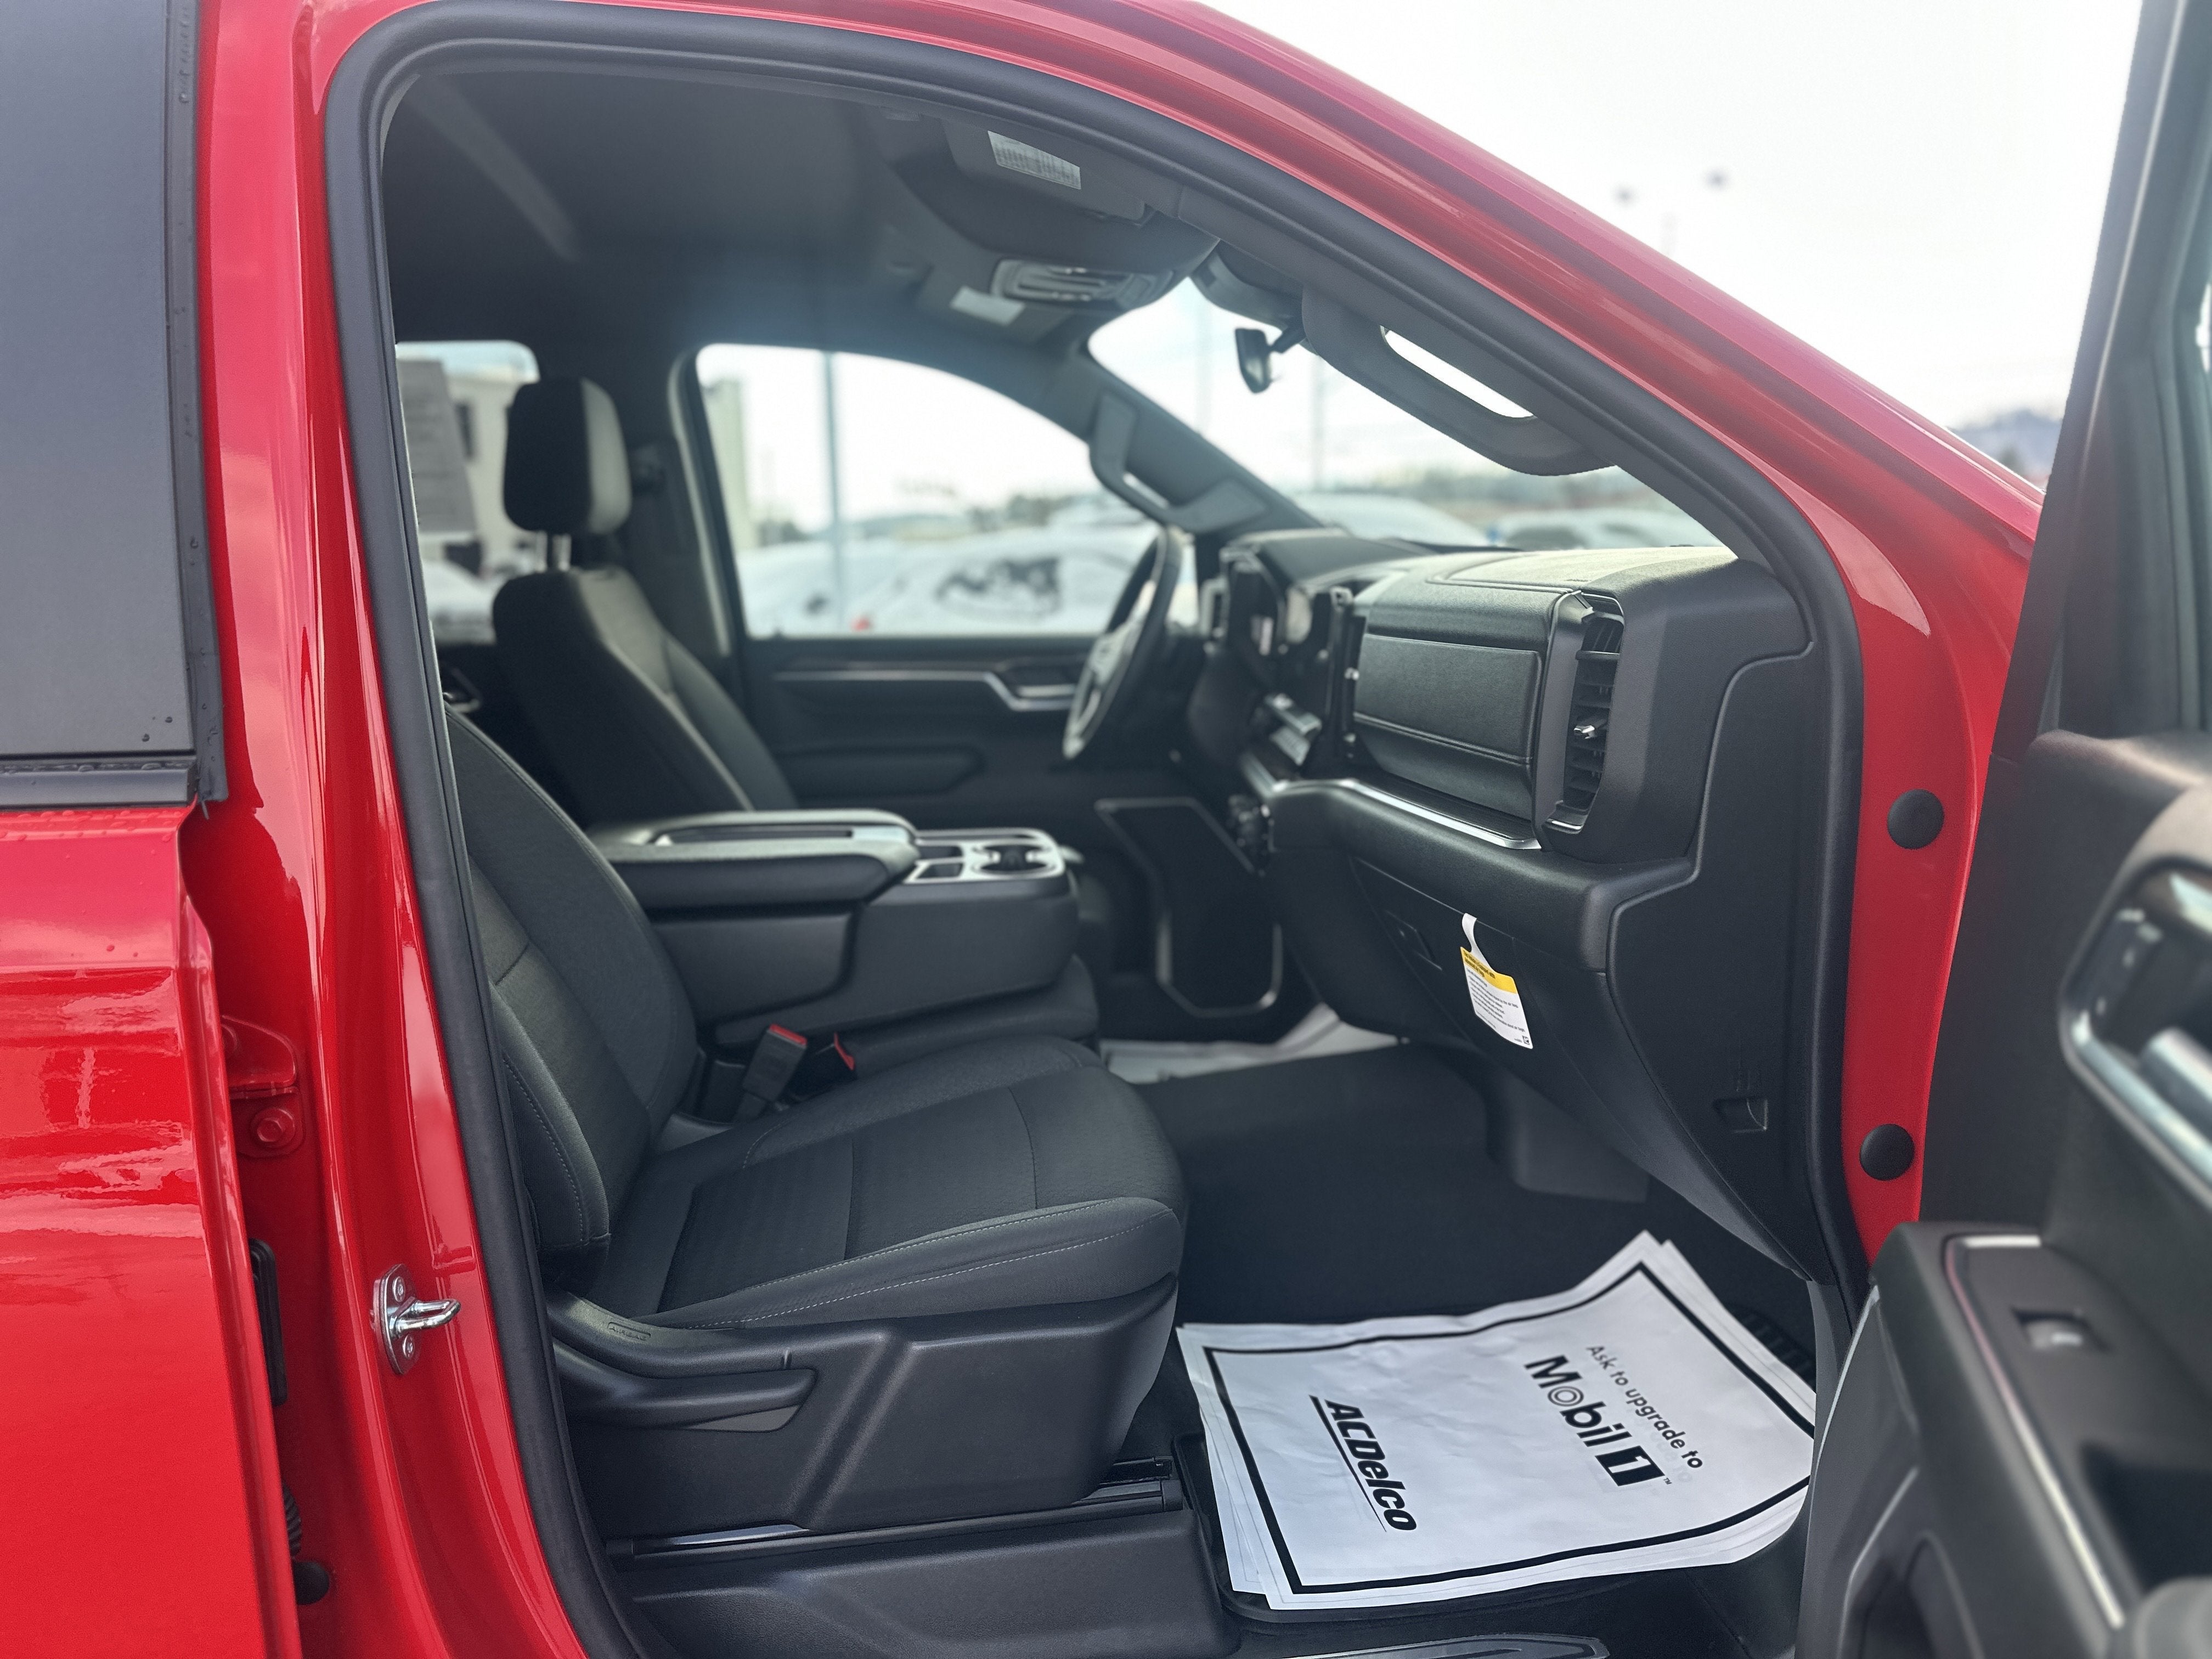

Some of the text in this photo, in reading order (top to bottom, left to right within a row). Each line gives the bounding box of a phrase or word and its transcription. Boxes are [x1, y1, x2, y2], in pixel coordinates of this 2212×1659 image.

[1523, 1355, 1633, 1447] Mobil
[1586, 1346, 1703, 1468] Ask to upgrade to
[1324, 1399, 1417, 1531] ACDelco
